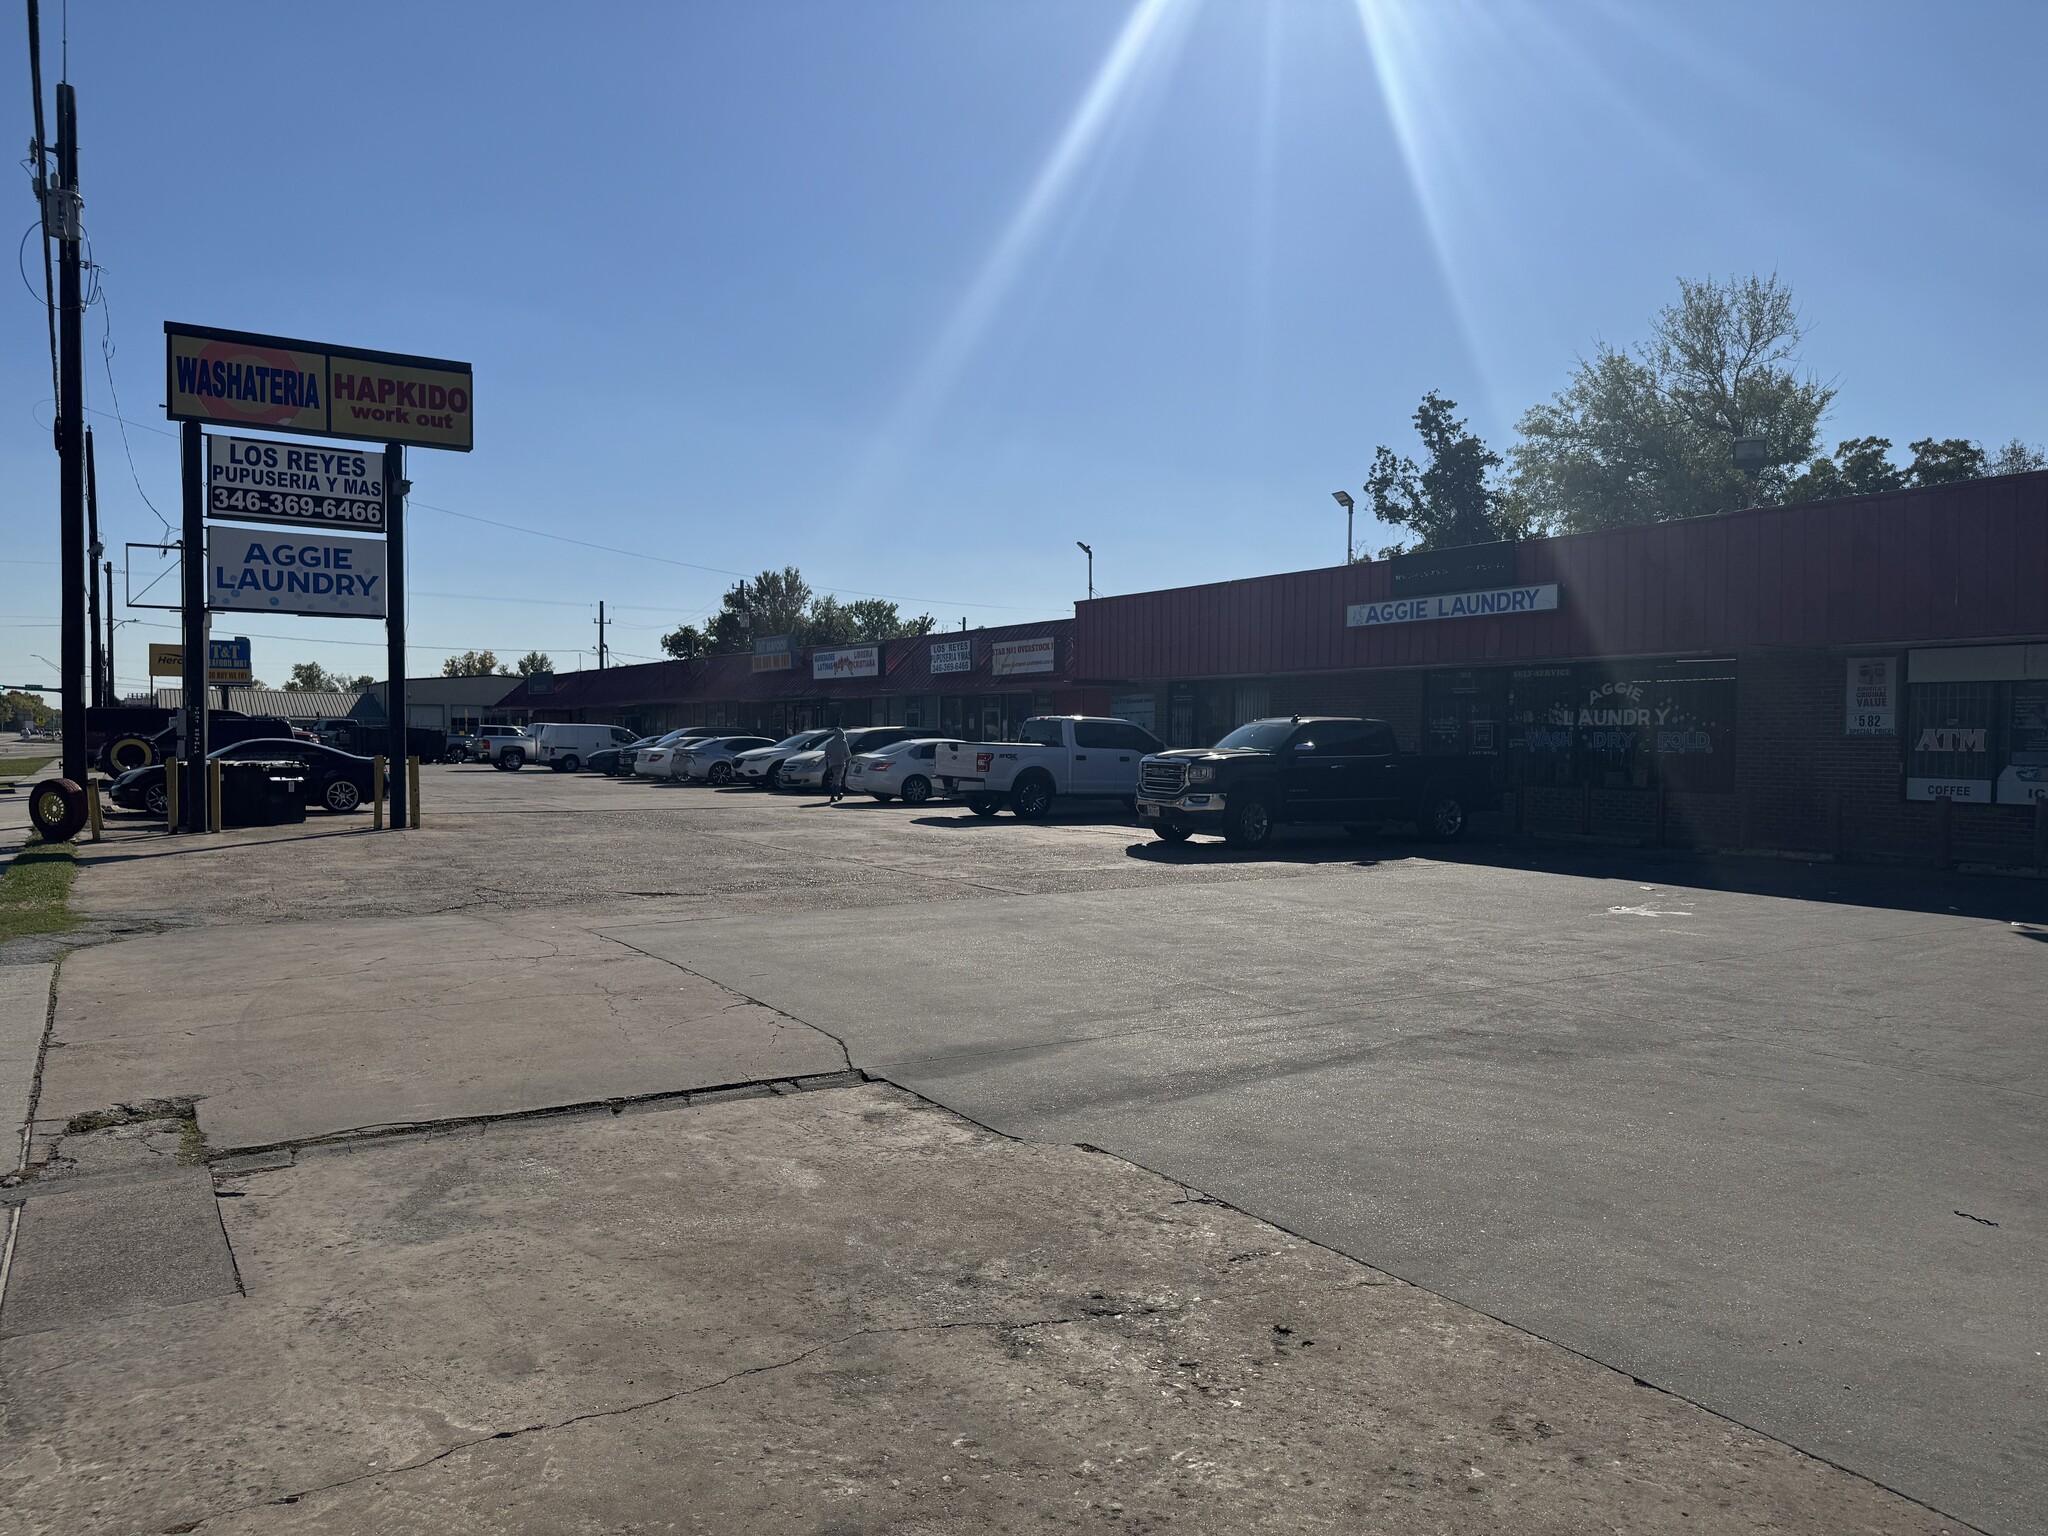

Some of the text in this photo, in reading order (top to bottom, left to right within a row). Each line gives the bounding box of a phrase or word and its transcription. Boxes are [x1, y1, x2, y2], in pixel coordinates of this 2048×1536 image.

[176, 355, 320, 410] WASHATERIA
[334, 373, 468, 414] HAPKIDO
[351, 406, 453, 429] work out
[229, 443, 366, 478] LOS REYES
[212, 465, 382, 497] PUPUSERIA Y MAS
[213, 487, 381, 522] 346-369-6466
[243, 543, 353, 570] AGGIE
[216, 566, 380, 597] LAUNDRY
[1365, 588, 1541, 624] AGGIE LAUNDRY
[210, 644, 240, 659] T&T
[933, 642, 968, 653] LOS REYES
[1018, 643, 1050, 653] OVERSTOCK
[1512, 668, 1573, 679] SELF-SERVICE
[1589, 681, 1645, 706] AGGIE
[1856, 697, 1887, 707] VALUE
[1563, 705, 1671, 726] LAUNDRY
[1527, 731, 1573, 748] WASH
[1593, 731, 1637, 748] DRY
[1657, 731, 1711, 749] FOLD
[1914, 728, 1987, 752] ATM
[1927, 785, 1971, 797] COFFEE
